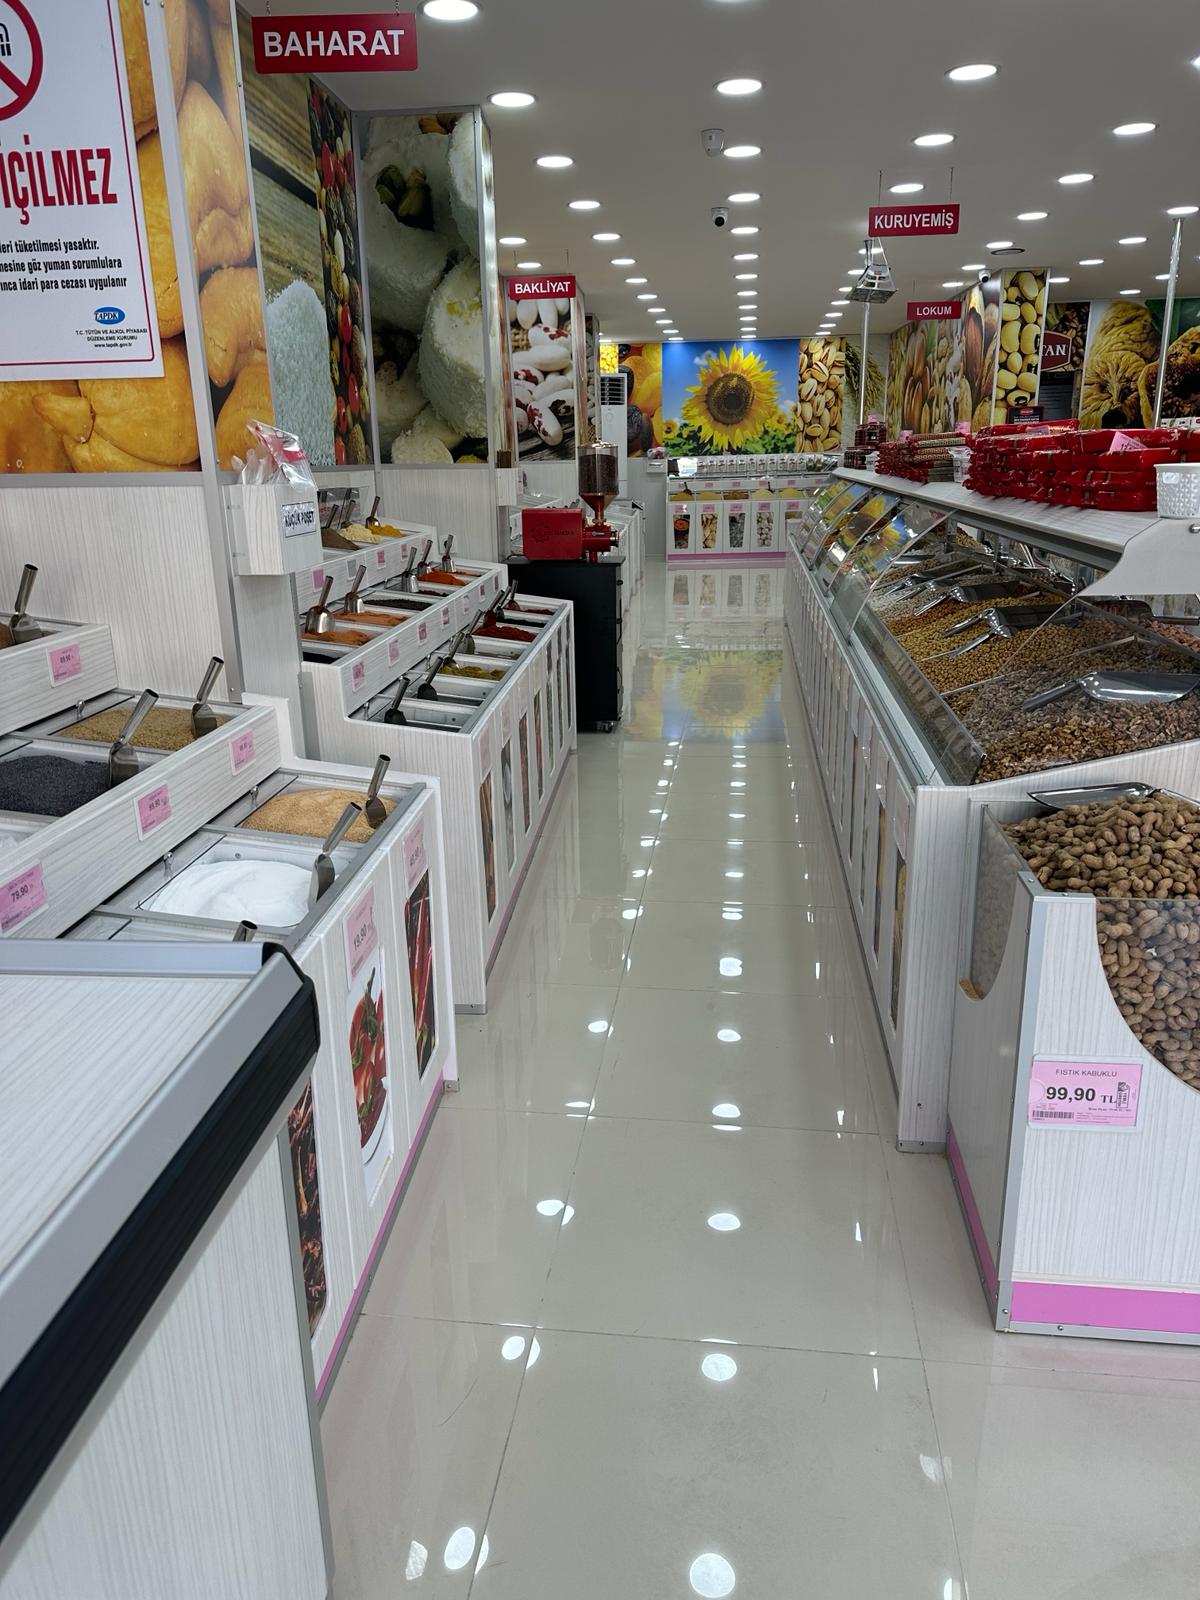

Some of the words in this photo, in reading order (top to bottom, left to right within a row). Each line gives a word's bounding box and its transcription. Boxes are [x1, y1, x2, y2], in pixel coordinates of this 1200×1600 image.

[263, 29, 405, 57] BAHARAT
[874, 209, 954, 229] KURUYEMİŞ
[14, 238, 62, 253] tüketilmesi
[63, 237, 100, 254] yasaktır.
[27, 258, 42, 274] göz
[43, 260, 71, 274] yuman
[72, 256, 123, 270] sorumlulara
[0, 281, 18, 291] ınca
[19, 278, 39, 291] idari
[40, 279, 59, 292] para
[60, 279, 87, 289] cezası
[88, 275, 128, 291] uygulanır
[514, 280, 571, 294] BAKLİYAT
[916, 306, 952, 316] LOKUM
[1046, 1086, 1096, 1103] 99,90
[1100, 1094, 1117, 1103] TL
